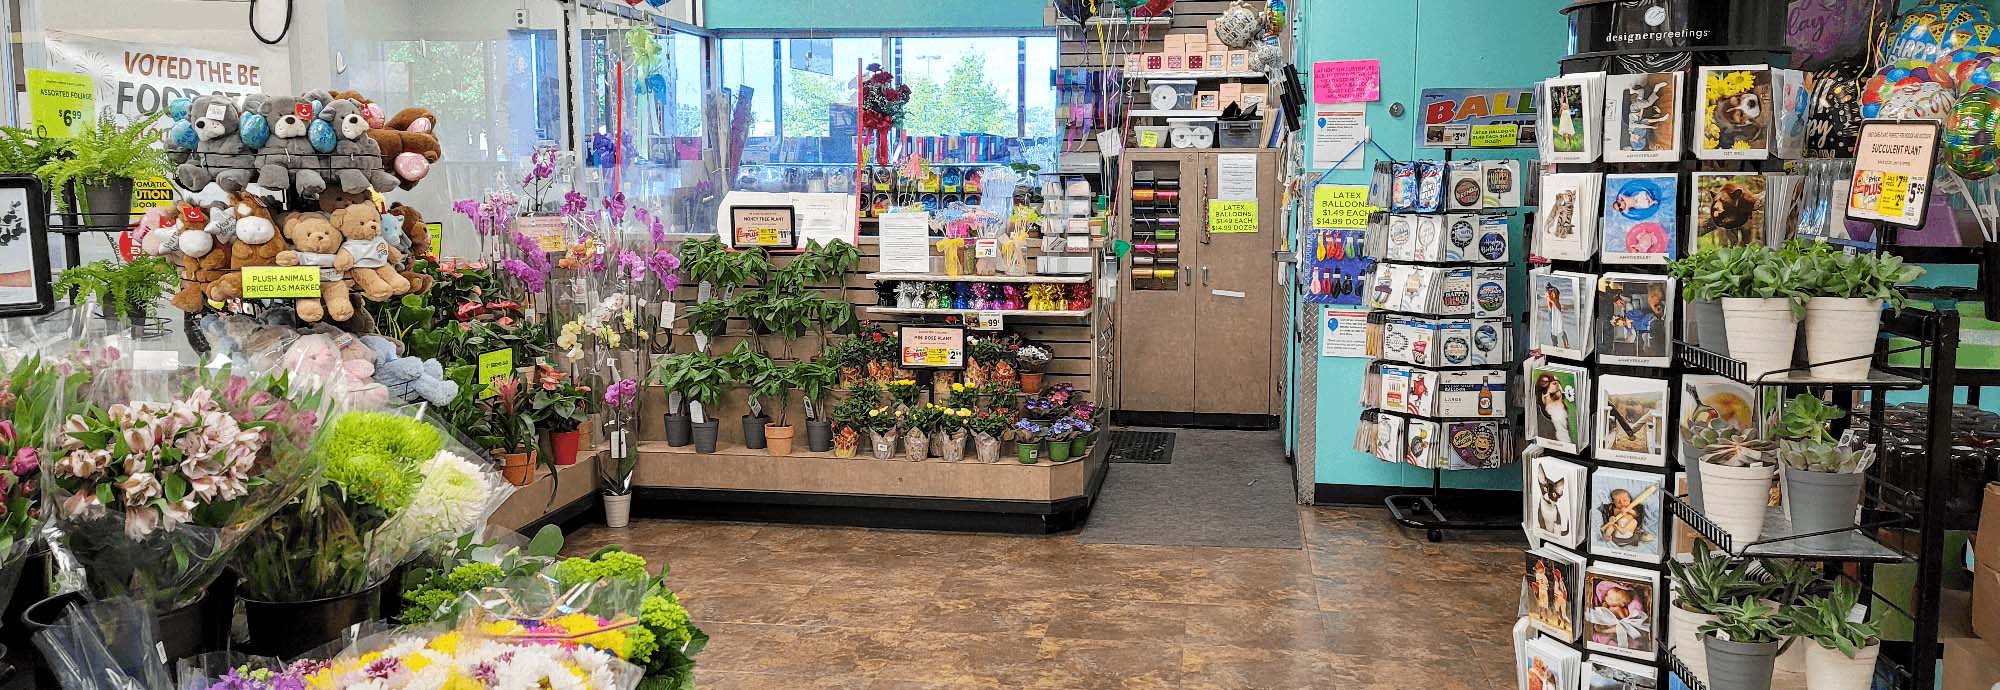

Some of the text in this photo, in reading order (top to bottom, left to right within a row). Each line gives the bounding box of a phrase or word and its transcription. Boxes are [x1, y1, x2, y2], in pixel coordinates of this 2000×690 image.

[124, 51, 192, 79] VOTED
[196, 59, 233, 83] THE
[40, 88, 70, 98] ASSORTED
[1871, 143, 1923, 156] SUCCULENT PLANT
[1863, 182, 1883, 196] PLUS
[1333, 191, 1361, 199] LATEX
[1347, 209, 1369, 217] EACH
[279, 274, 314, 282] ANIMALS
[246, 285, 274, 293] PRICED
[288, 283, 320, 292] MARKED
